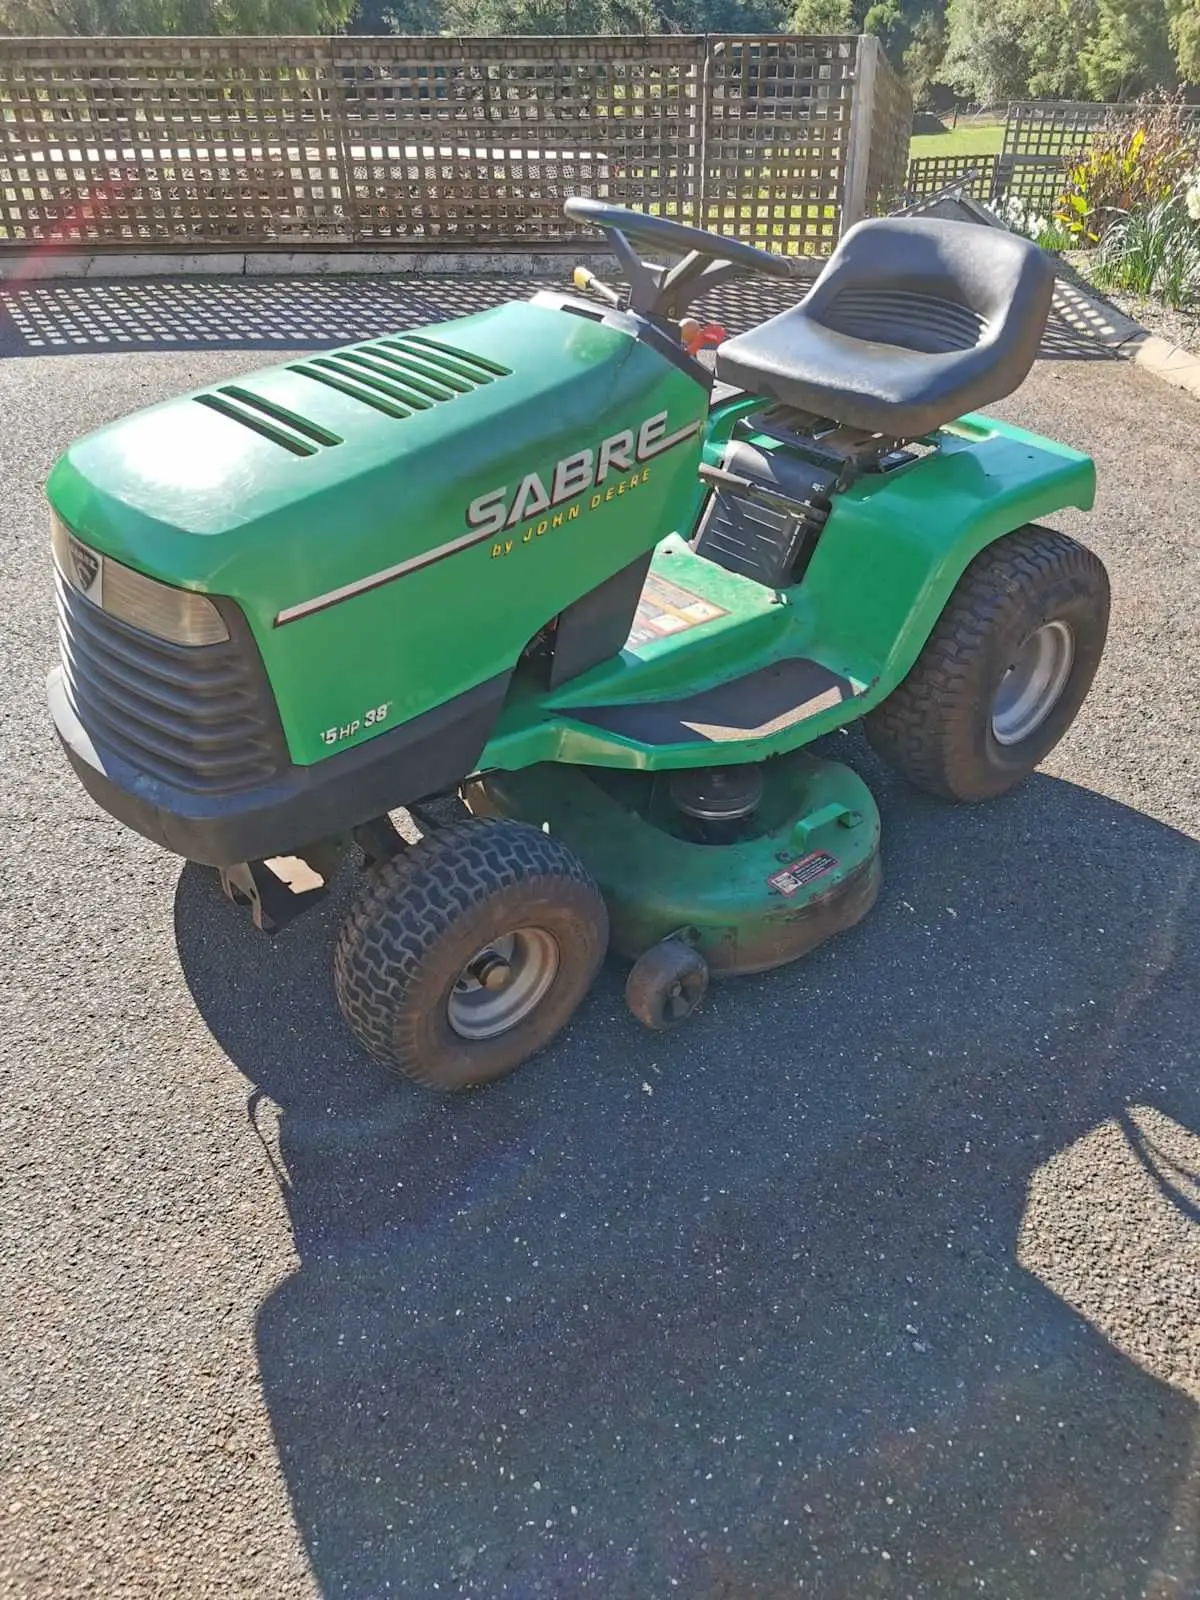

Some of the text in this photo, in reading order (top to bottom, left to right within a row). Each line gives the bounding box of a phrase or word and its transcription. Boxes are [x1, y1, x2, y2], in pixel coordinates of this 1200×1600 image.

[467, 410, 668, 529] SABRE
[491, 468, 651, 559] by JOHN DEERE
[339, 720, 360, 740] HP
